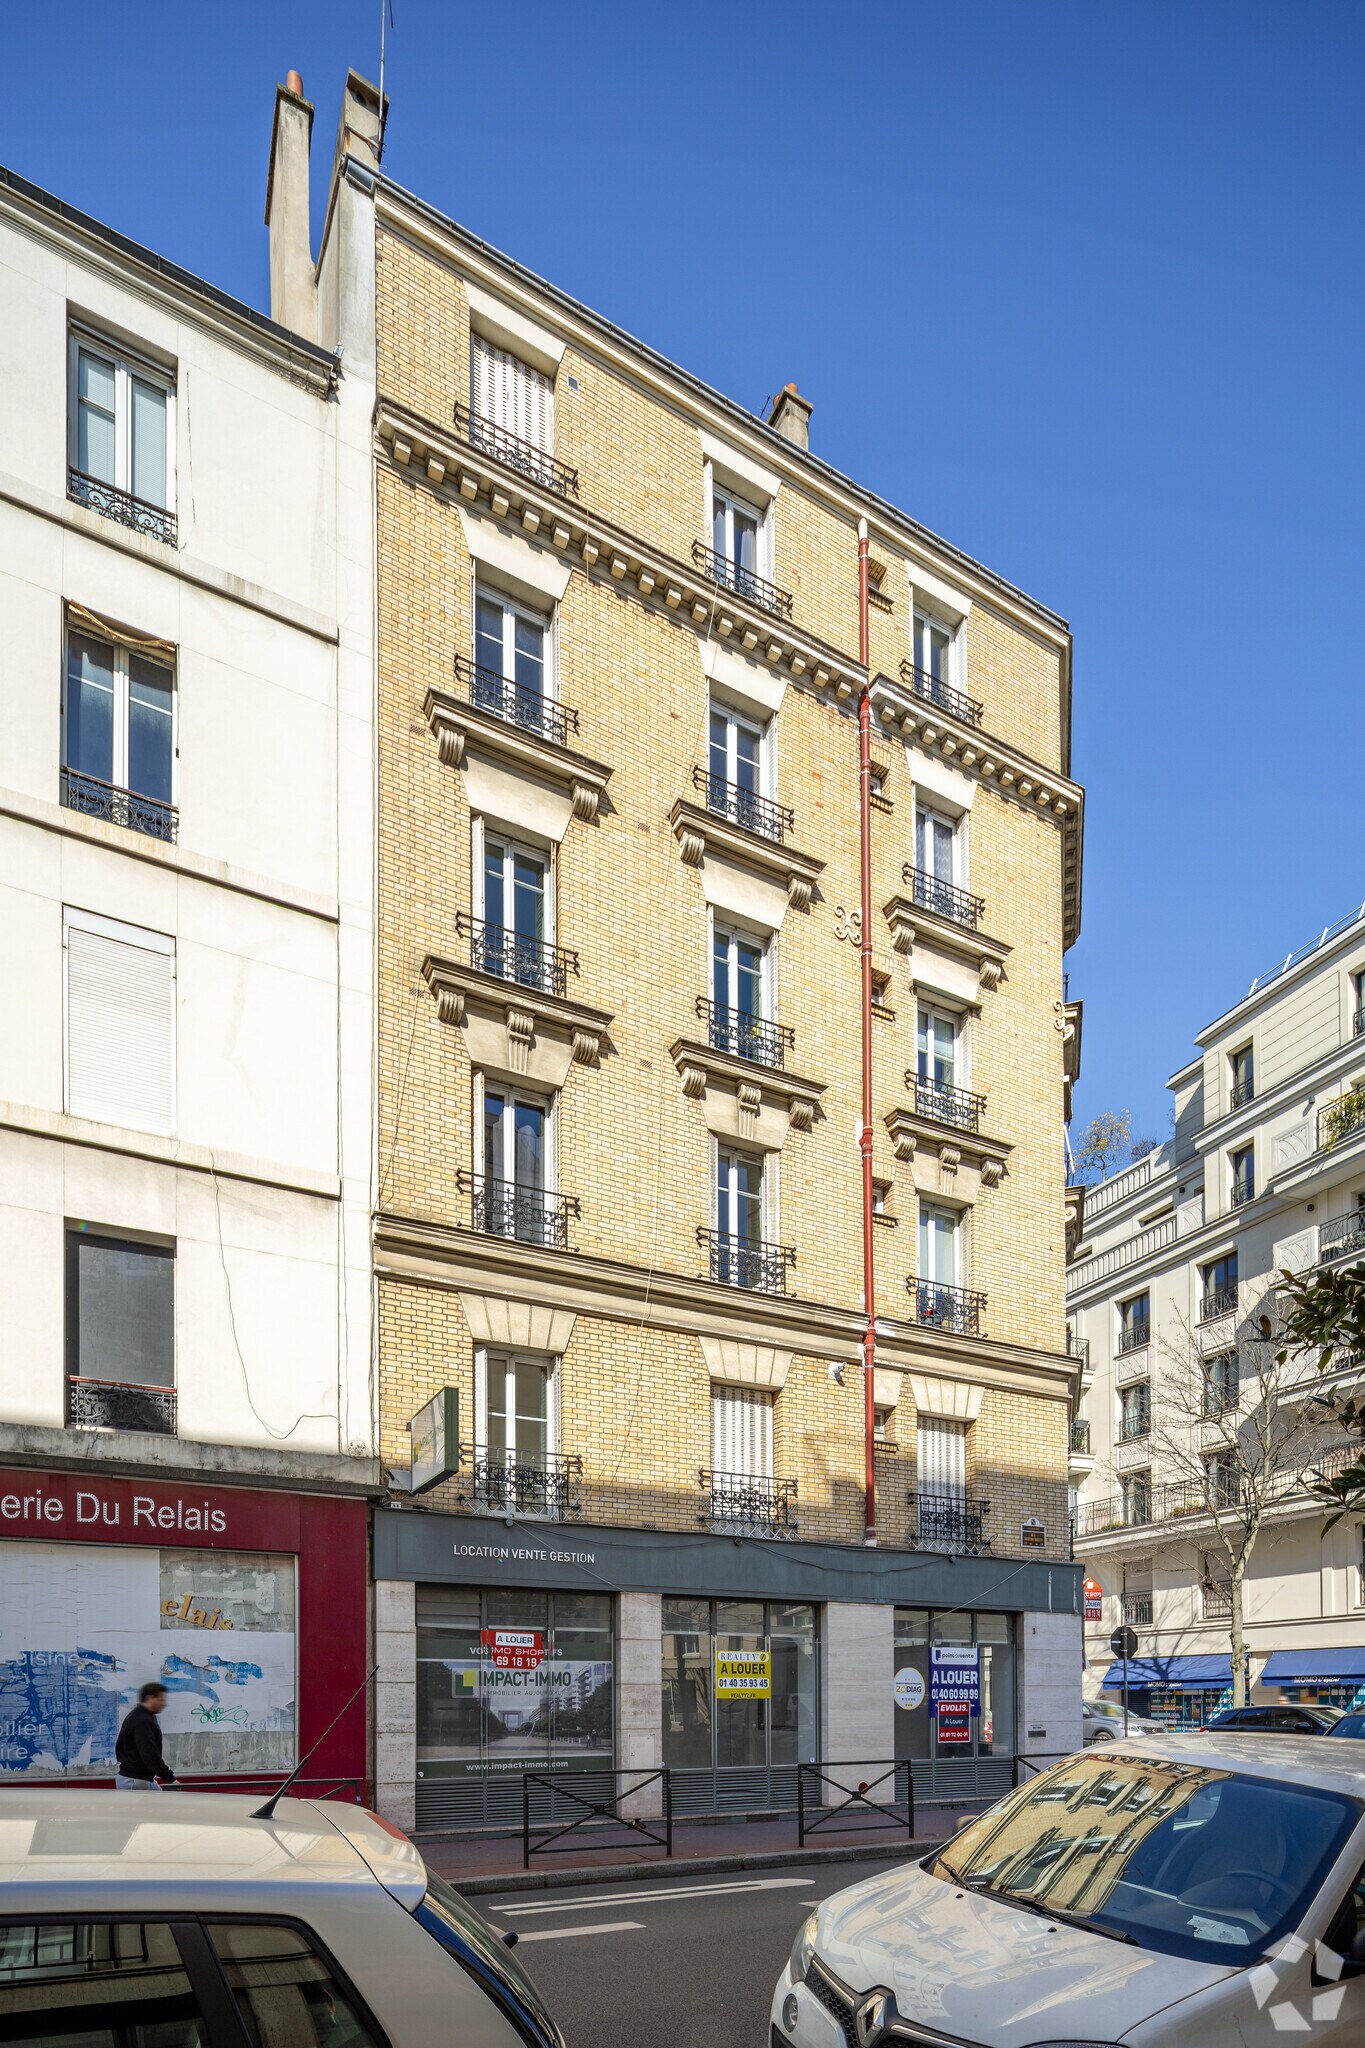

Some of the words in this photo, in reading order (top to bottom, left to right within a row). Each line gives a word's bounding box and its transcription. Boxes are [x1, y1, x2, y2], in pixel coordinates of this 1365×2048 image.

[0, 1489, 63, 1521] erie
[77, 1492, 119, 1525] Du
[133, 1496, 226, 1532] Relais
[453, 1544, 508, 1558] LOCATION
[511, 1548, 547, 1560] VENTE
[550, 1551, 595, 1563] GESTION
[505, 1636, 533, 1644] LOUER
[496, 1656, 509, 1666] 69
[511, 1656, 523, 1667] 18
[525, 1657, 537, 1667] 19
[721, 1663, 728, 1674] A
[731, 1663, 765, 1674] LOUER
[478, 1671, 571, 1687] IMPACT-IMMO
[719, 1678, 727, 1687] 01
[729, 1678, 737, 1687] 40
[739, 1678, 748, 1687] 35
[749, 1678, 758, 1687] 93
[759, 1678, 768, 1687] 45
[932, 1670, 939, 1684] A
[941, 1670, 978, 1684] LOUER
[1294, 1676, 1318, 1684] MOMO
[939, 1688, 948, 1699] 40
[949, 1688, 958, 1699] 60
[959, 1688, 968, 1699] 99
[969, 1688, 979, 1700] 99
[466, 1760, 569, 1771] www.impact-immo.com
